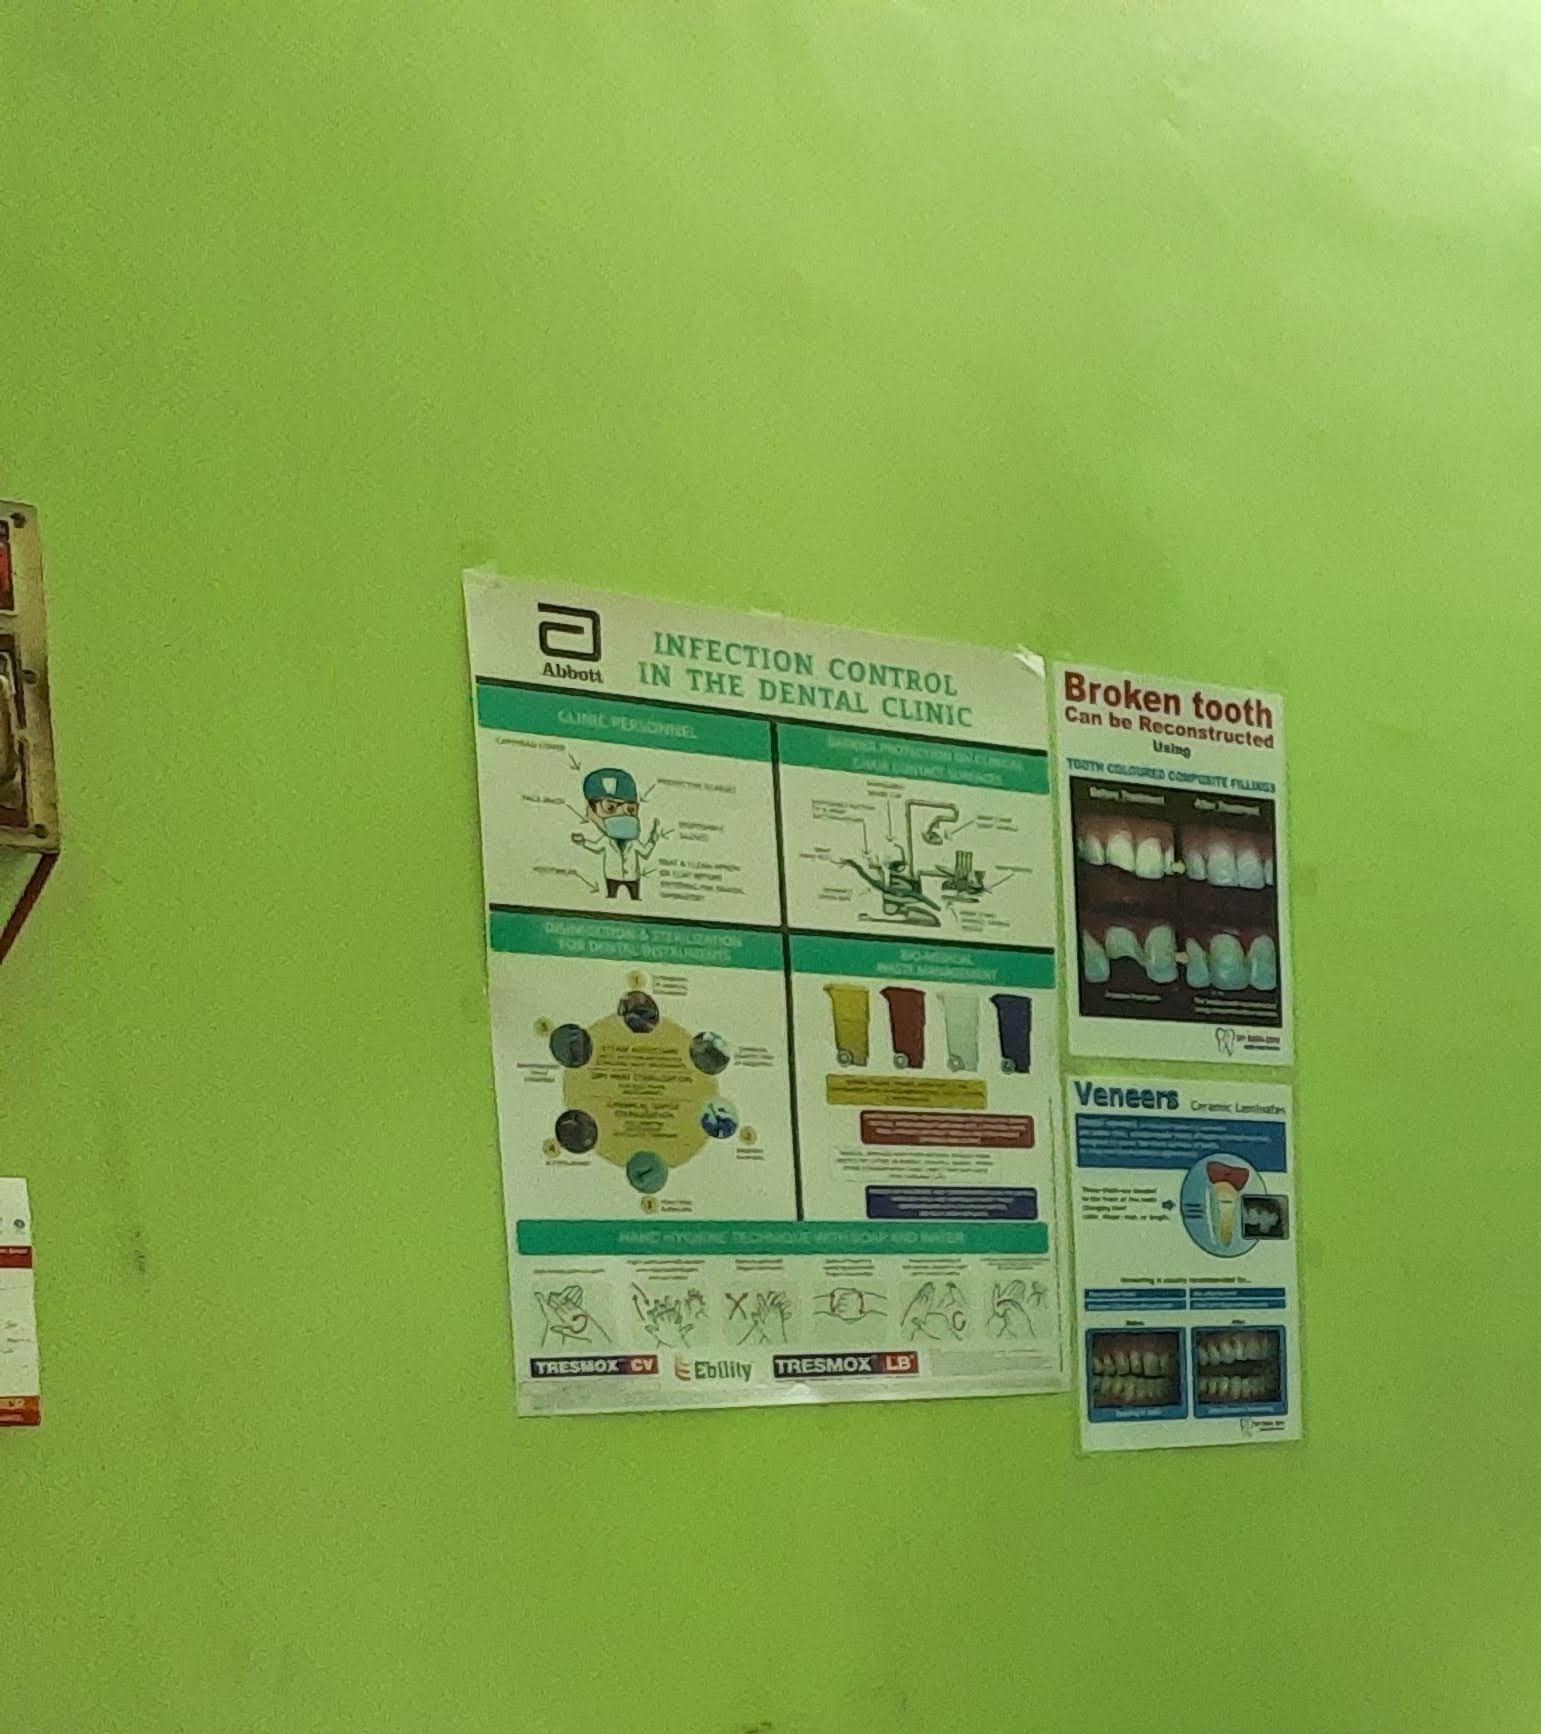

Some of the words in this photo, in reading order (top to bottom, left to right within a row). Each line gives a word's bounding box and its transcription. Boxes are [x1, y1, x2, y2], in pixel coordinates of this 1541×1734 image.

[542, 662, 604, 684] Abbott
[654, 632, 813, 675] INFECTION
[829, 658, 958, 697] CONTROL
[638, 661, 671, 688] IN
[686, 668, 745, 697] THE
[759, 679, 869, 714] DENTAL
[882, 697, 973, 727] CLINIC
[1064, 671, 1181, 716] Broken
[1192, 691, 1273, 729] tooth
[1065, 706, 1102, 726] Can
[1109, 712, 1132, 729] be
[1139, 715, 1274, 749] Reconstructed
[1153, 739, 1191, 759] Using
[1066, 757, 1104, 772] TOOTH
[1107, 762, 1165, 780] COLOURED
[1168, 769, 1228, 788] COMPOSITE
[1074, 1081, 1180, 1110] Veneers
[536, 1359, 619, 1375] TRESMOX
[631, 1357, 655, 1372] CV
[694, 1360, 752, 1382] Ebility
[774, 1356, 873, 1374] TRESMOX
[884, 1354, 914, 1371] LB
